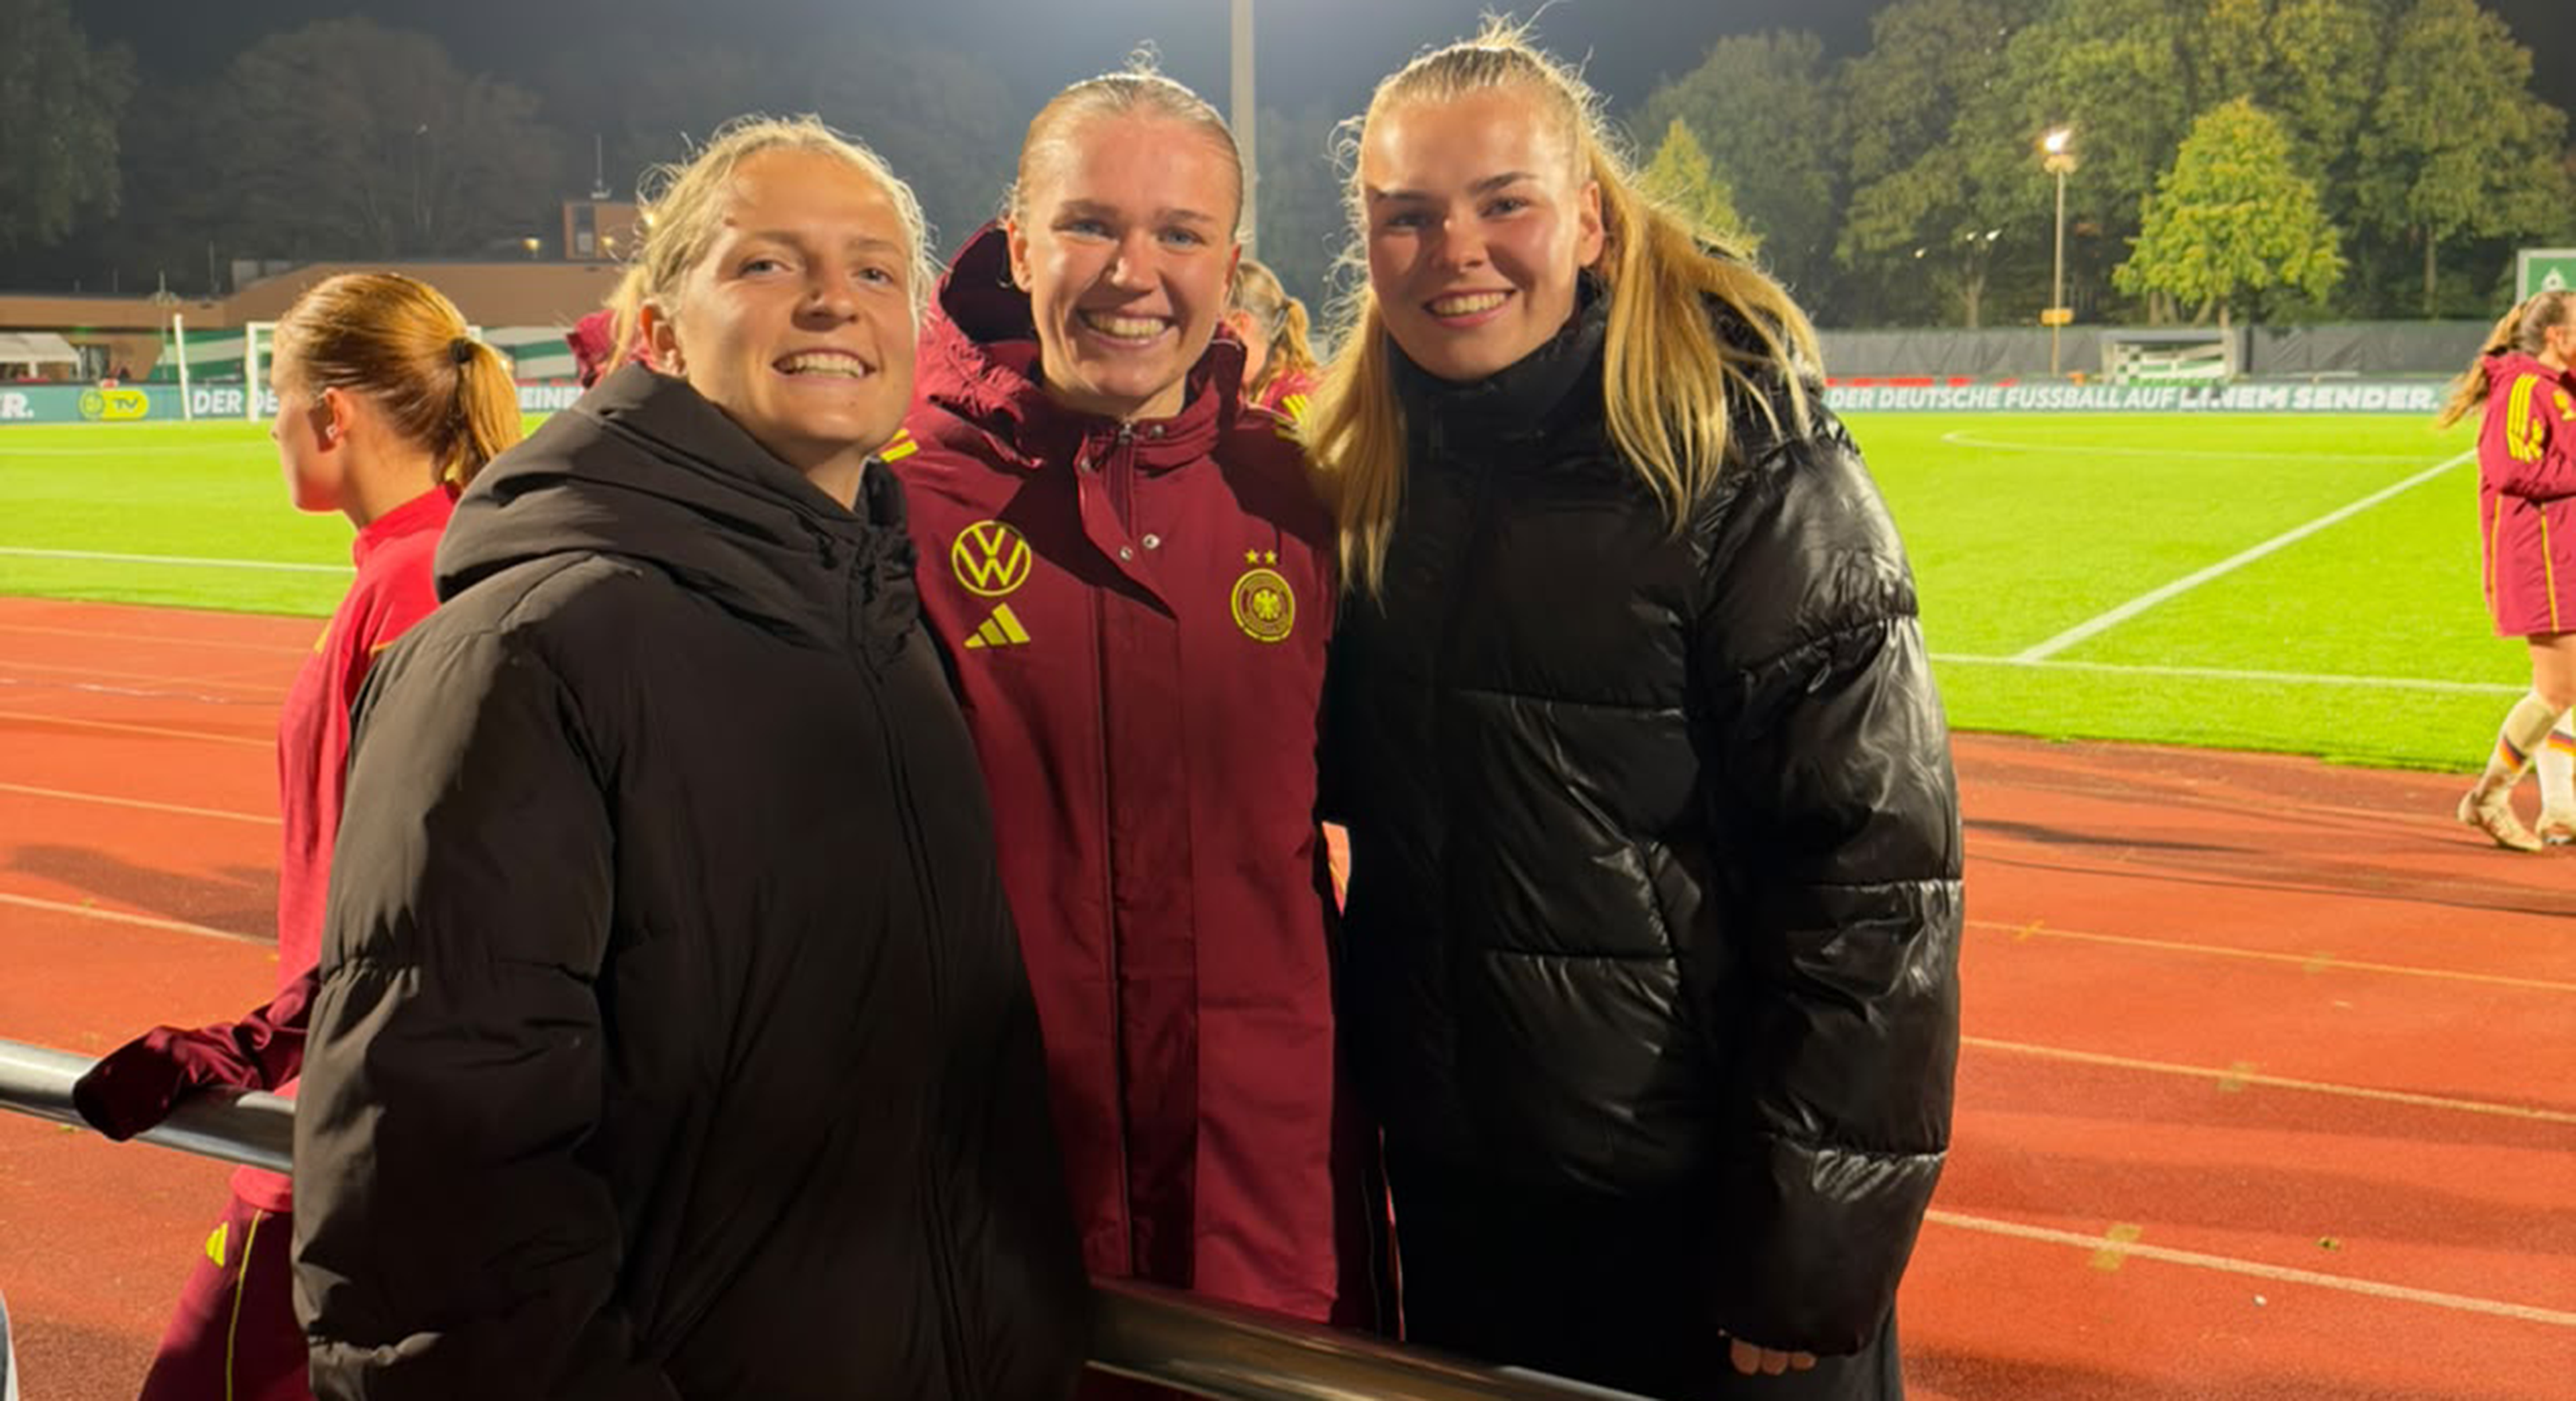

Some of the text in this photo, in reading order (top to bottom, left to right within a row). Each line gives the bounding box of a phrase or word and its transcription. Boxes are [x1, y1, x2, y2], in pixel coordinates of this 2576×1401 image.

[0, 393, 34, 419] R.
[113, 398, 138, 410] TV
[193, 389, 243, 414] DER
[1827, 389, 1875, 408] DER
[1877, 388, 1999, 408] DEUTSCHE
[2003, 387, 2120, 408] FUSSBALL
[2123, 387, 2178, 408] AUF
[2292, 387, 2440, 409] SENDER.
